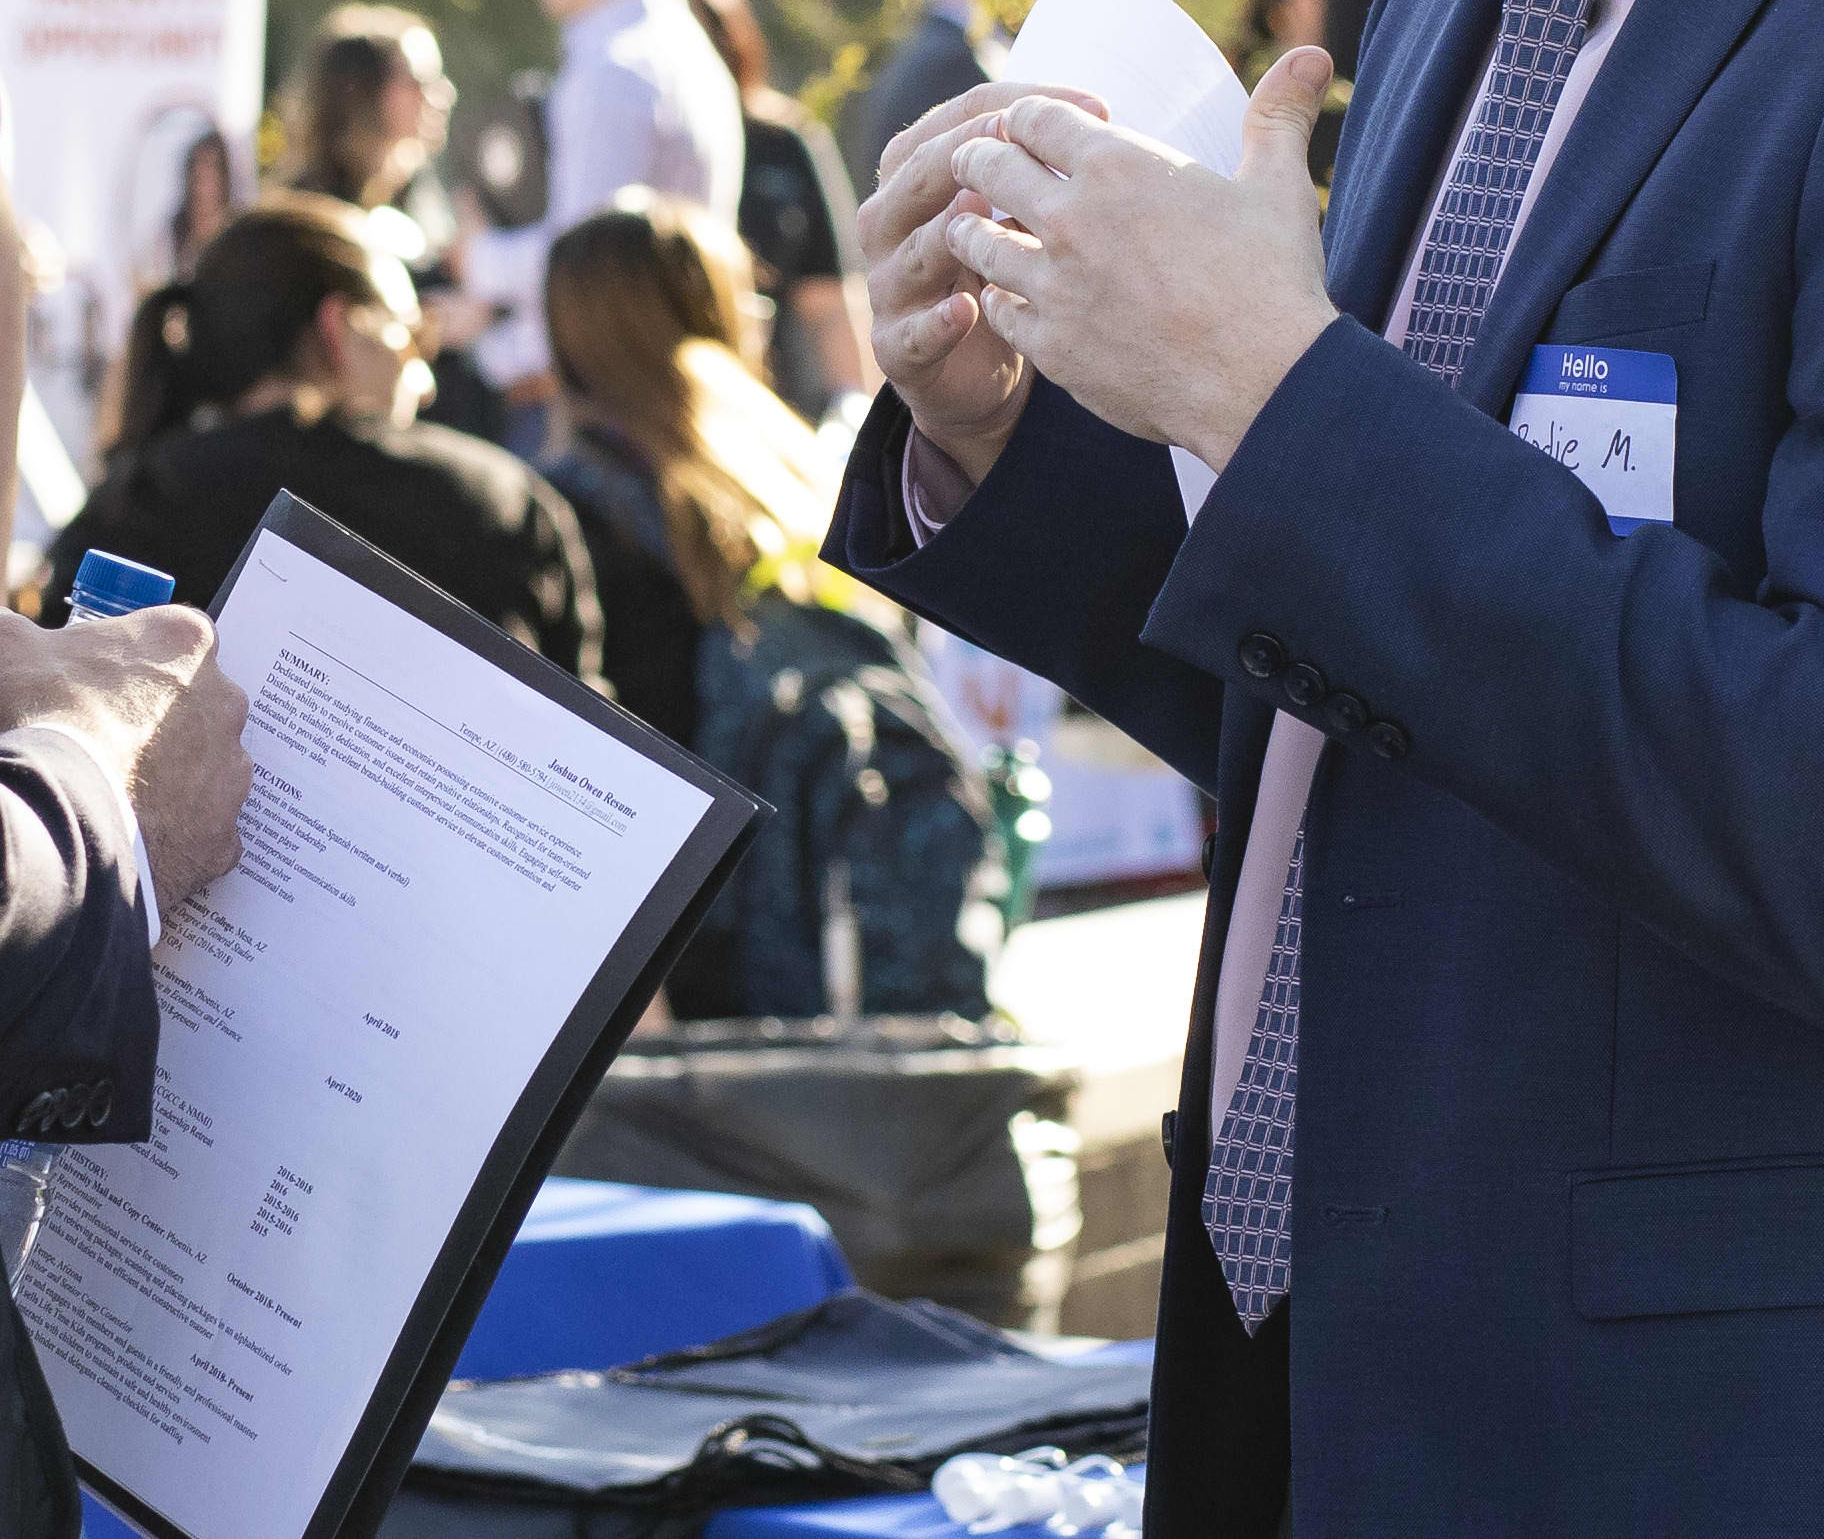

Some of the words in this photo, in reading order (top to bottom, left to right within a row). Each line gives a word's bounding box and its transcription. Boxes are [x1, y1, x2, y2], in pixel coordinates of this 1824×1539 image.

[1561, 352, 1609, 380] Hello
[1559, 381, 1570, 393] my
[1571, 382, 1598, 393] name
[1600, 383, 1608, 393] is
[1601, 428, 1636, 472] M.
[278, 648, 331, 686] SUMMARY:
[244, 709, 277, 735] increase
[276, 731, 310, 757] company
[308, 751, 328, 768] sales.
[459, 722, 482, 746] Tempe,
[482, 739, 498, 752] AZ
[265, 671, 297, 698] Distinct
[294, 692, 321, 713] ability
[319, 706, 329, 718] to
[327, 712, 355, 734] resolve
[353, 728, 386, 753] customer
[383, 745, 406, 765] issues
[404, 761, 421, 774] and
[416, 768, 438, 786] retain
[434, 780, 463, 801] positive
[460, 796, 502, 826] relationships.
[501, 819, 540, 848] Recognized
[536, 841, 549, 854] for
[546, 848, 592, 881] team-oriented
[272, 660, 312, 690] Dedicated
[307, 682, 334, 703] junior
[331, 699, 364, 725] studying
[362, 715, 390, 738] finance
[387, 733, 404, 747] and
[401, 742, 437, 768] economics
[433, 763, 471, 791] possessing
[468, 785, 500, 808] extensive
[498, 803, 528, 824] customer
[525, 820, 550, 838] service
[547, 834, 583, 860] experience.
[253, 698, 290, 726] dedicated
[287, 719, 297, 731] to
[294, 726, 332, 755] providing
[330, 747, 362, 771] excellent
[360, 763, 408, 802] brand-building
[406, 796, 437, 818] customer
[434, 813, 459, 832] service
[456, 826, 466, 838] to
[464, 832, 488, 851] elevate
[486, 846, 516, 868] customer
[513, 863, 543, 886] retention
[540, 880, 557, 893] and
[259, 684, 298, 718] leadership,
[298, 711, 335, 740] reliability,
[335, 732, 371, 763] dedication,
[371, 757, 388, 771] and
[384, 765, 416, 789] excellent
[413, 781, 457, 814] interpersonal
[453, 808, 502, 843] communication
[499, 836, 519, 854] skills.
[517, 846, 549, 874] Engaging
[546, 867, 582, 892] self-starter
[547, 758, 579, 784] Joshua
[578, 776, 604, 799] Owen
[602, 791, 637, 819] Resume
[261, 807, 297, 833] motivated
[293, 825, 327, 854] leadership
[261, 823, 280, 841] team
[276, 835, 301, 853] player
[278, 797, 289, 810] in
[286, 802, 328, 835] intermediate
[325, 828, 352, 851] Spanish
[349, 844, 376, 866] (written
[374, 861, 390, 873] and
[387, 868, 411, 888] verbal)
[242, 849, 272, 872] problem
[269, 866, 292, 883] solver
[253, 835, 297, 868] interpersonal
[293, 863, 341, 897] communication
[338, 891, 357, 908] skills
[277, 888, 296, 904] traits
[166, 935, 184, 952] GPA
[176, 906, 202, 928] Degree
[199, 921, 209, 933] in
[206, 926, 234, 948] General
[230, 939, 256, 963] Studies
[181, 927, 198, 943] List
[193, 936, 234, 968] (2016-2018)
[209, 910, 235, 935] College,
[234, 926, 254, 947] Mesa,
[253, 940, 269, 954] AZ
[159, 964, 195, 996] University,
[193, 987, 221, 1015] Phoenix,
[220, 1007, 236, 1021] AZ
[169, 989, 205, 1018] Economics
[202, 1013, 218, 1026] and
[214, 1016, 243, 1043] Finance
[362, 1012, 385, 1029] April
[381, 1022, 401, 1040] 2018
[177, 1100, 187, 1112] &
[324, 1075, 347, 1094] April
[343, 1086, 363, 1104] 2020
[153, 1100, 191, 1133] Leadership
[188, 1124, 215, 1149] Retreat
[154, 1117, 171, 1136] Year
[147, 1133, 169, 1154] Team
[69, 1148, 109, 1182] HISTORY:
[149, 1152, 181, 1181] Academy
[276, 1165, 314, 1195] 2016-2018
[269, 1178, 289, 1197] 2016
[91, 1179, 110, 1199] Mail
[107, 1193, 124, 1208] and
[122, 1201, 142, 1222] Copy
[140, 1213, 166, 1239] Center,
[165, 1229, 194, 1258] Phoenix,
[193, 1250, 208, 1265] AZ
[256, 1205, 293, 1236] 2015-2016
[262, 1192, 300, 1223] 2015-2016
[249, 1219, 270, 1238] 2015
[226, 1271, 256, 1297] October
[253, 1290, 275, 1310] 2018-
[274, 1303, 303, 1330] Present
